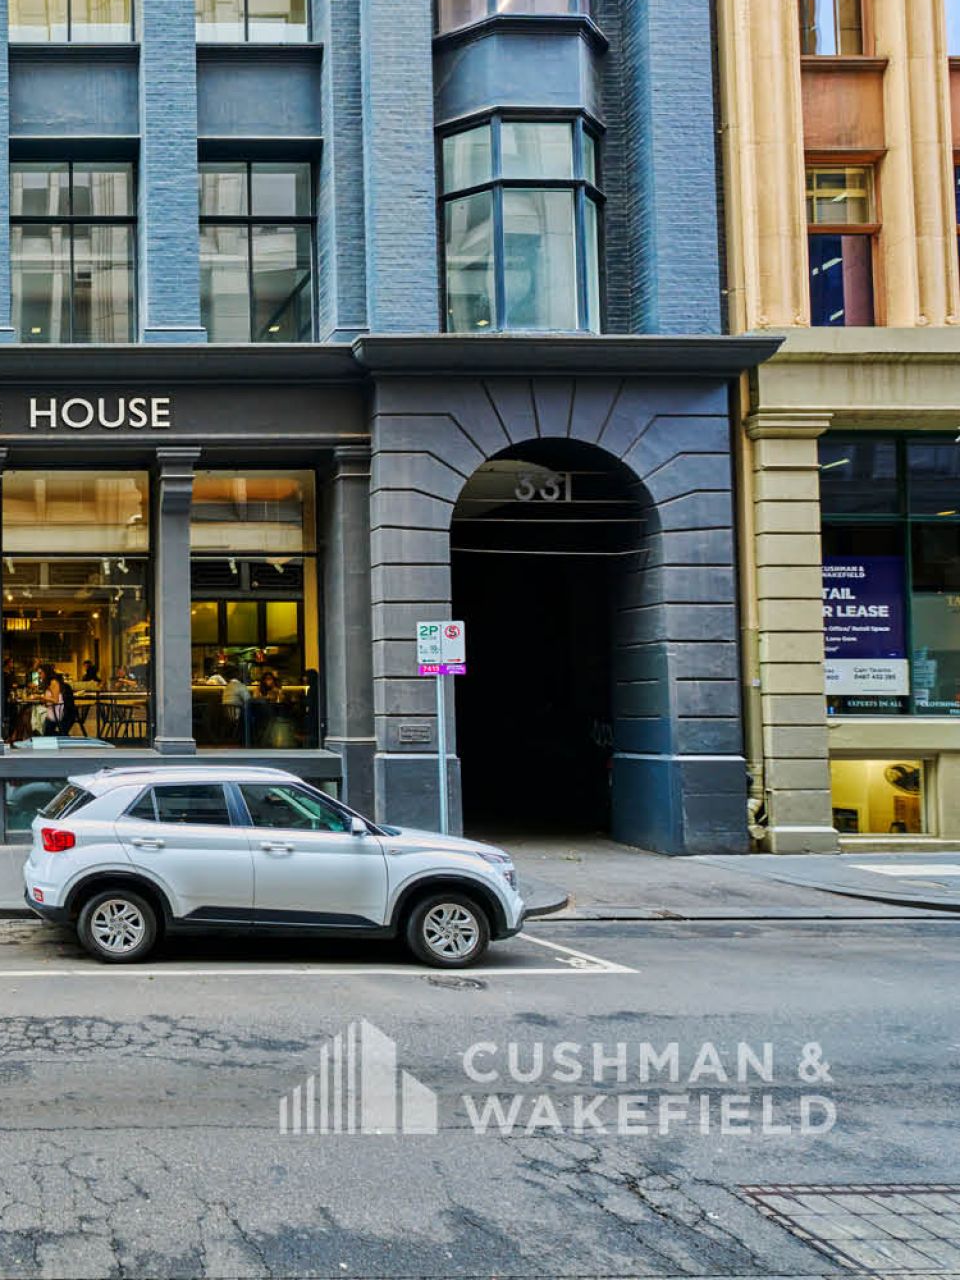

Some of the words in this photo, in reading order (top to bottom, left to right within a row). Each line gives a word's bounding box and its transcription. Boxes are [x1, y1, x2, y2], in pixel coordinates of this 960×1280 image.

[30, 398, 171, 429] HOUSE
[515, 471, 572, 502] 331
[836, 605, 890, 618] LEASE
[420, 625, 439, 637] 2P
